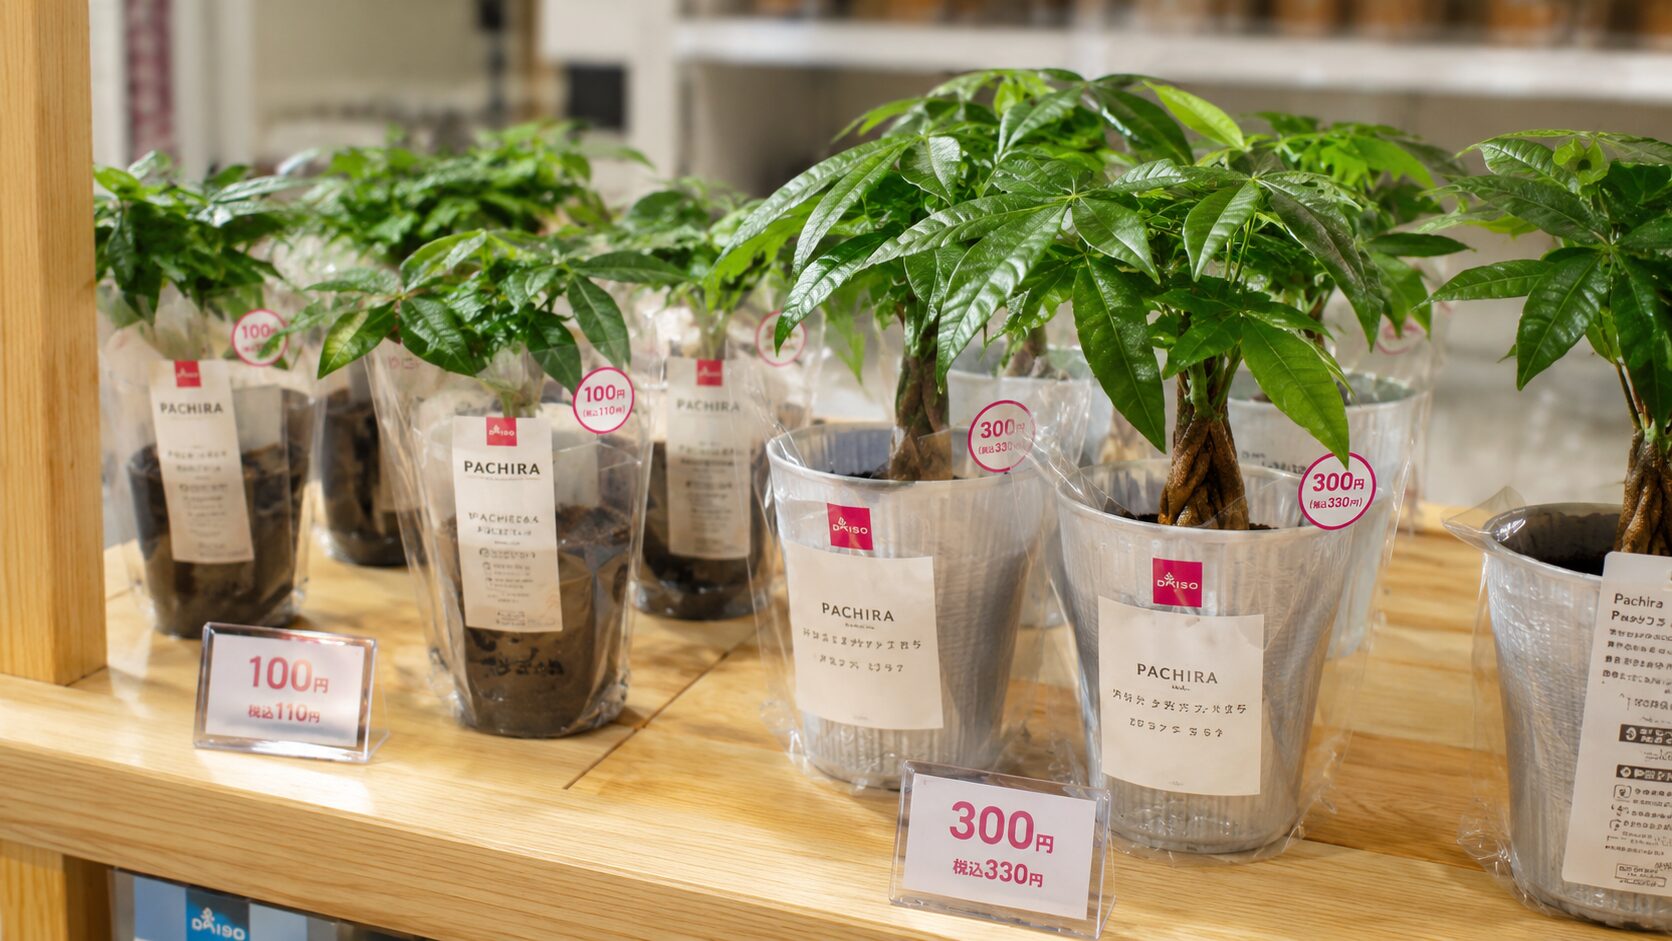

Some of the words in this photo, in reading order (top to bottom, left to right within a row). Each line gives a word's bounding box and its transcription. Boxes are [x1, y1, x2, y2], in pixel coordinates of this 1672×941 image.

[584, 384, 626, 403] 100円
[159, 402, 224, 415] PACHIRA
[463, 460, 541, 475] PACHIRA
[1312, 472, 1365, 492] 300円
[832, 517, 868, 535] DAISO
[1156, 572, 1199, 590] DAISO
[1614, 592, 1664, 609] Pachira
[821, 602, 895, 622] PACHIRA
[249, 655, 330, 694] 100円
[1137, 663, 1218, 684] PACHIRA
[247, 702, 321, 724] 税込110円
[949, 800, 1055, 854] 300円
[952, 858, 1044, 888] 税込330円
